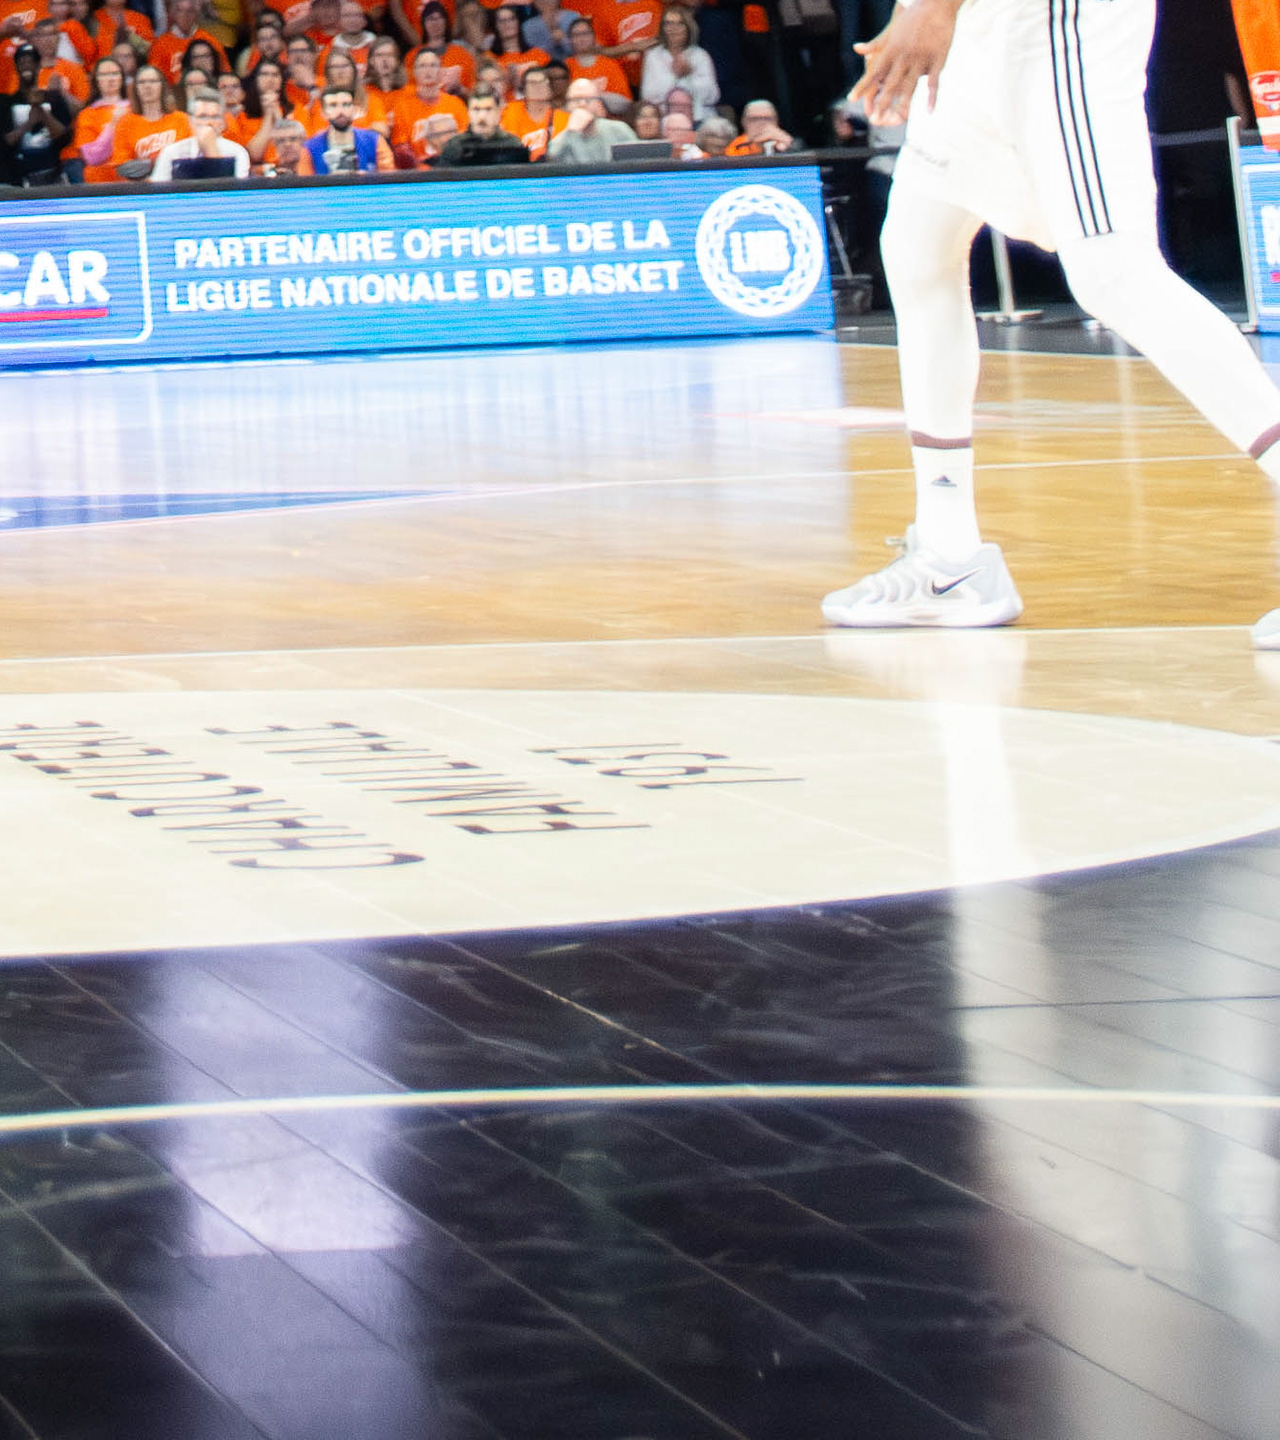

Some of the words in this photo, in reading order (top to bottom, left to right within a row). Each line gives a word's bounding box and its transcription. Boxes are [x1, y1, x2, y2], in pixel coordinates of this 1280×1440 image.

[175, 227, 397, 270] PARTENAIRE
[403, 223, 561, 263] OFFICIEL
[567, 221, 614, 252] DE
[622, 219, 670, 251] LA
[166, 279, 273, 313] LIGUE
[282, 267, 477, 309] NATIONALE
[487, 267, 534, 298] DE
[543, 260, 683, 297] BASKET
